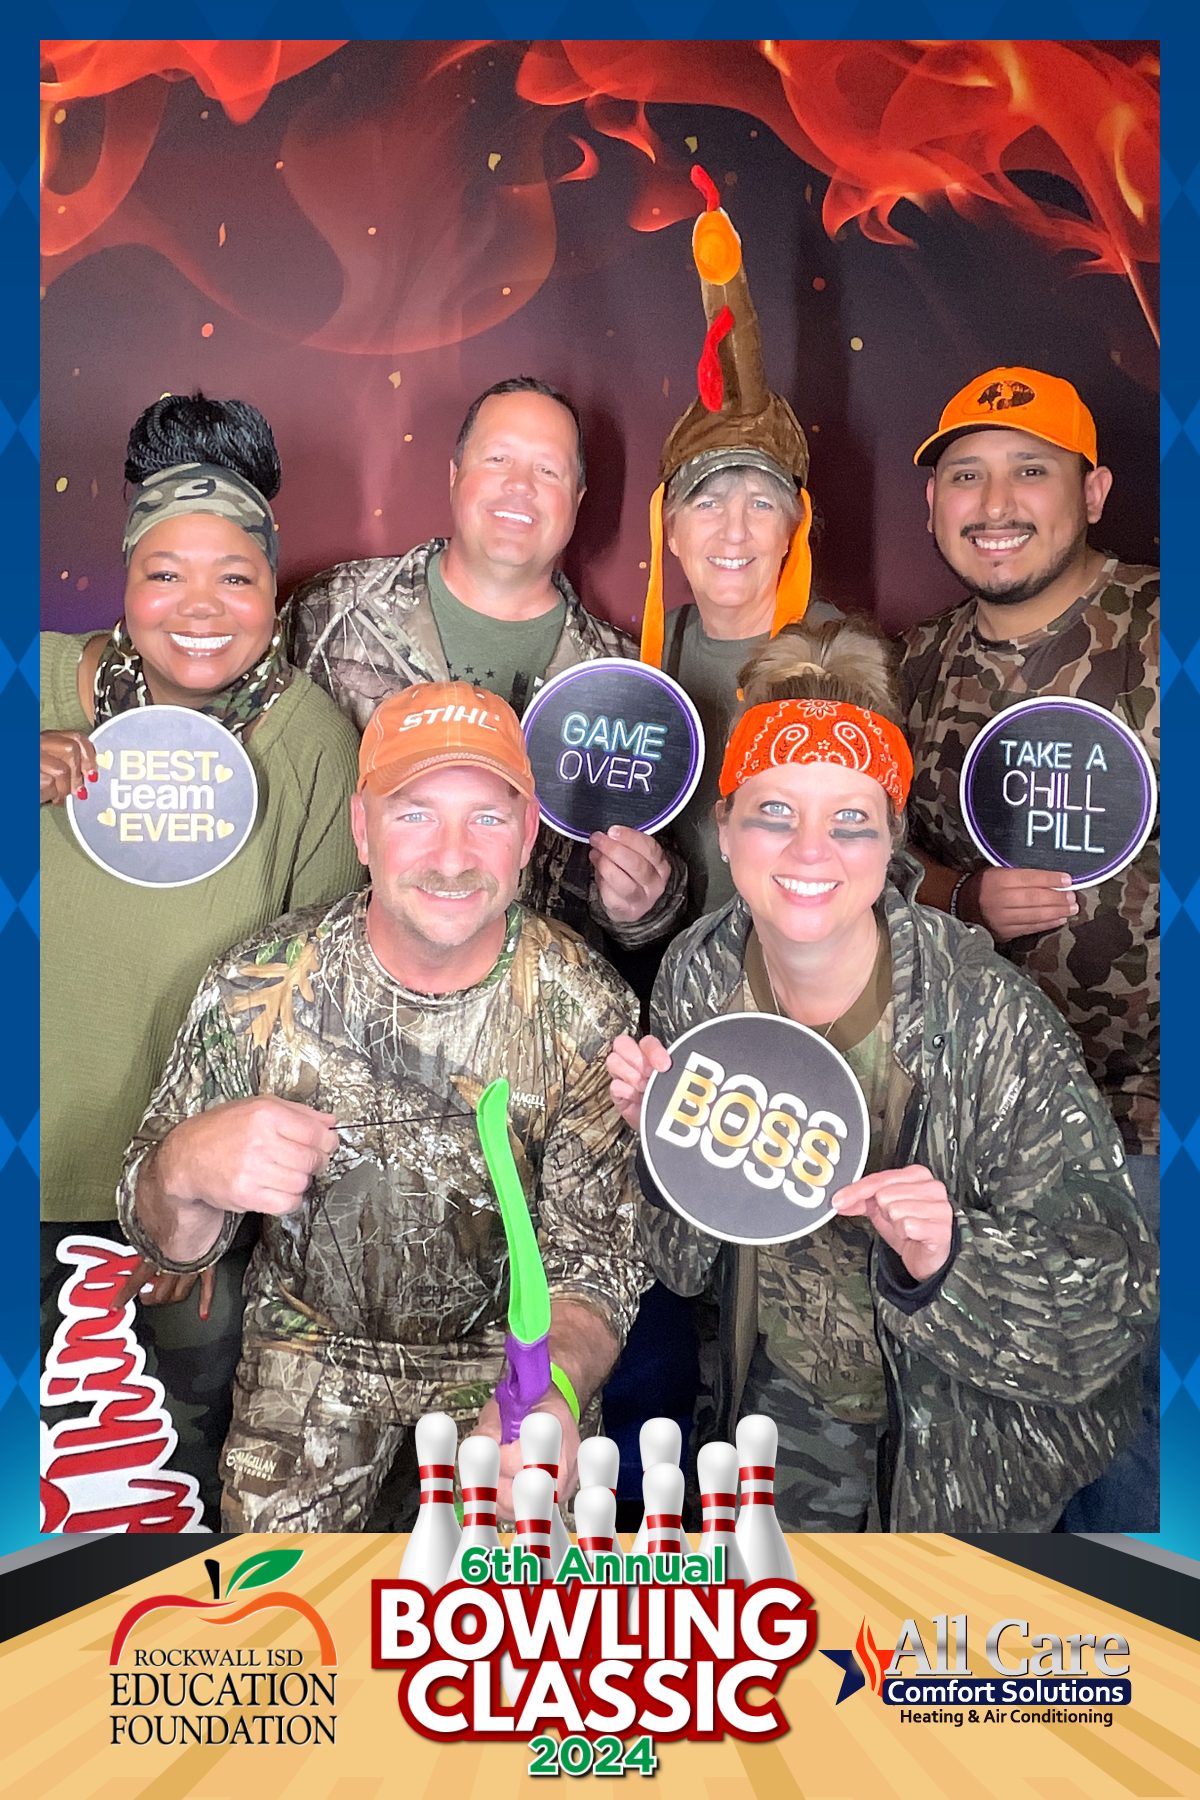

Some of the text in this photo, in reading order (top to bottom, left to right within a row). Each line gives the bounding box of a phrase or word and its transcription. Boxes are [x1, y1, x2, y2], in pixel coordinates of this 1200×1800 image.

[399, 704, 498, 732] STIHL
[563, 712, 667, 759] GAME
[119, 749, 219, 782] BEST
[559, 750, 654, 793] OVER
[1000, 740, 1108, 771] TAKE A
[110, 778, 215, 810] team
[1002, 769, 1106, 812] CHILL
[119, 812, 215, 842] EVER
[1026, 809, 1105, 853] PILL
[664, 1066, 841, 1188] BOSS
